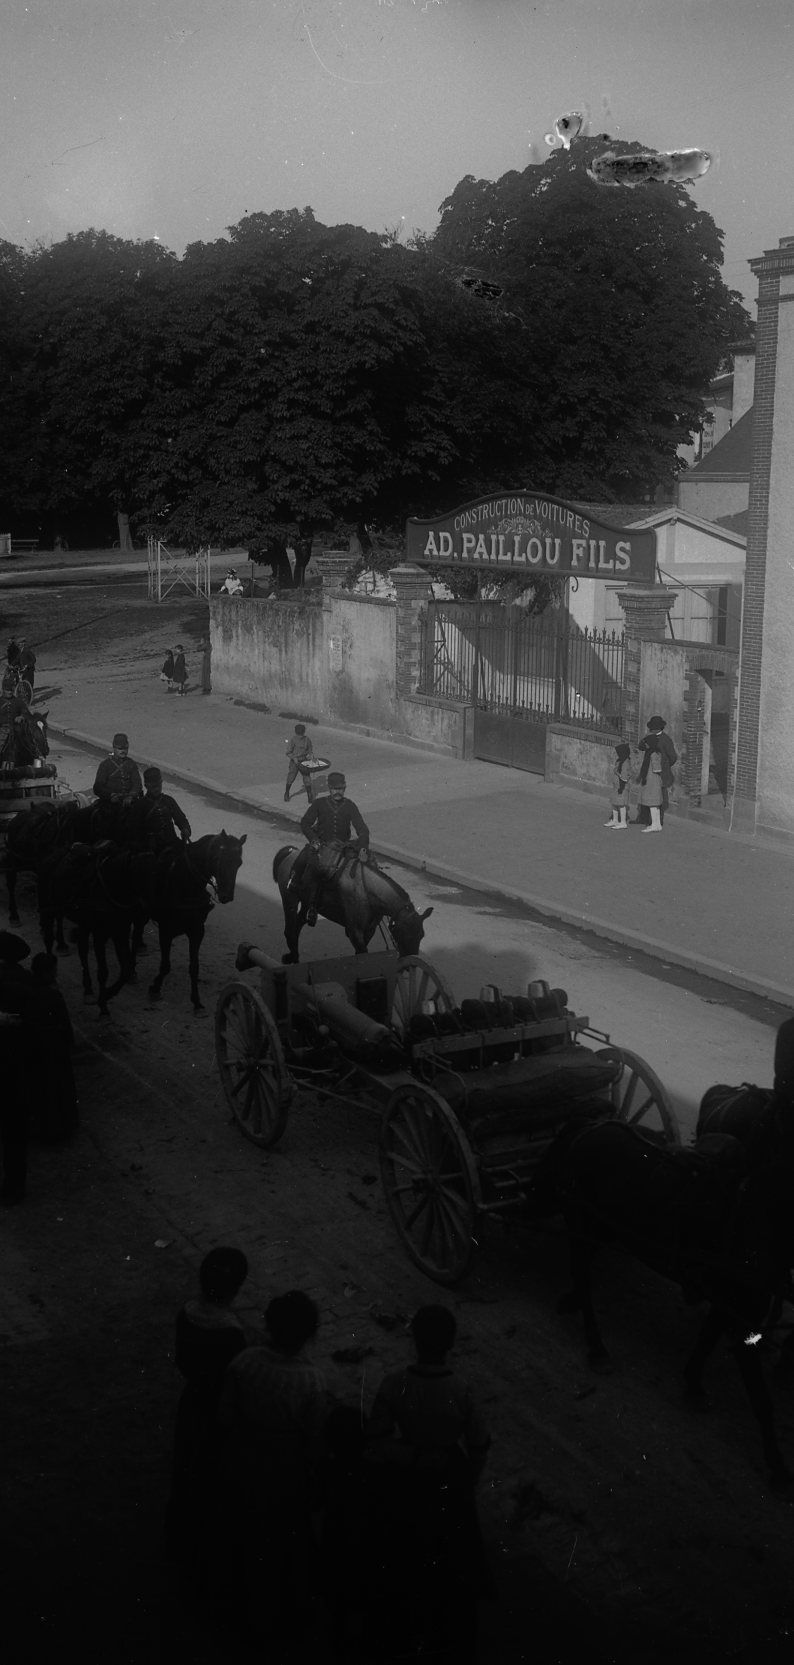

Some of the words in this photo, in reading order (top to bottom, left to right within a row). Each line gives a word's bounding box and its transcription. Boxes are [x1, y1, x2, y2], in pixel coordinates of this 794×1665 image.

[454, 498, 525, 531] CONSTRUCTION
[525, 503, 535, 515] DE
[534, 500, 590, 537] VOITURES
[423, 530, 459, 558] AD.
[461, 533, 561, 565] PAILLOU
[570, 538, 631, 570] FILS
